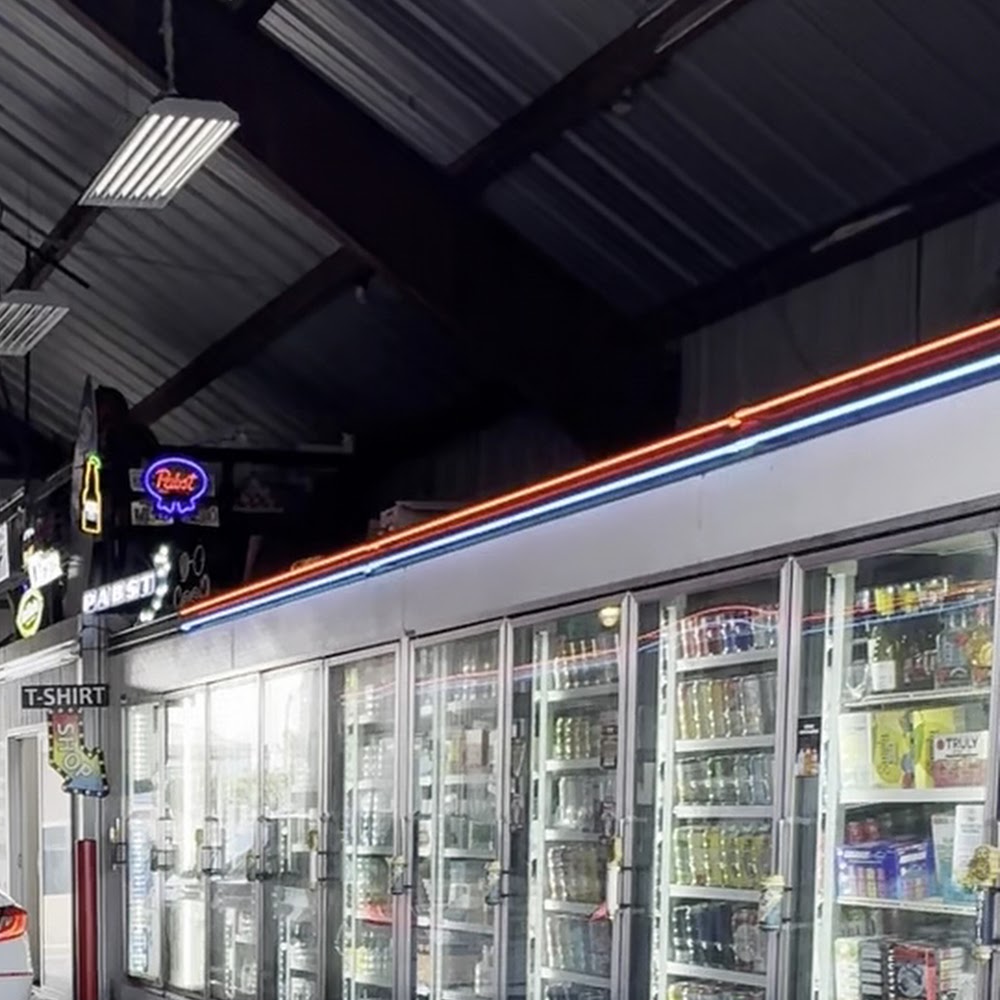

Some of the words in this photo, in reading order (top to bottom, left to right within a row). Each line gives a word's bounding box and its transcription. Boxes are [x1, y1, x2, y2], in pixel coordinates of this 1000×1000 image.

[83, 569, 156, 615] PABST
[23, 686, 106, 706] T-SHIRT
[57, 723, 93, 777] SHOP
[945, 737, 979, 750] TRULY
